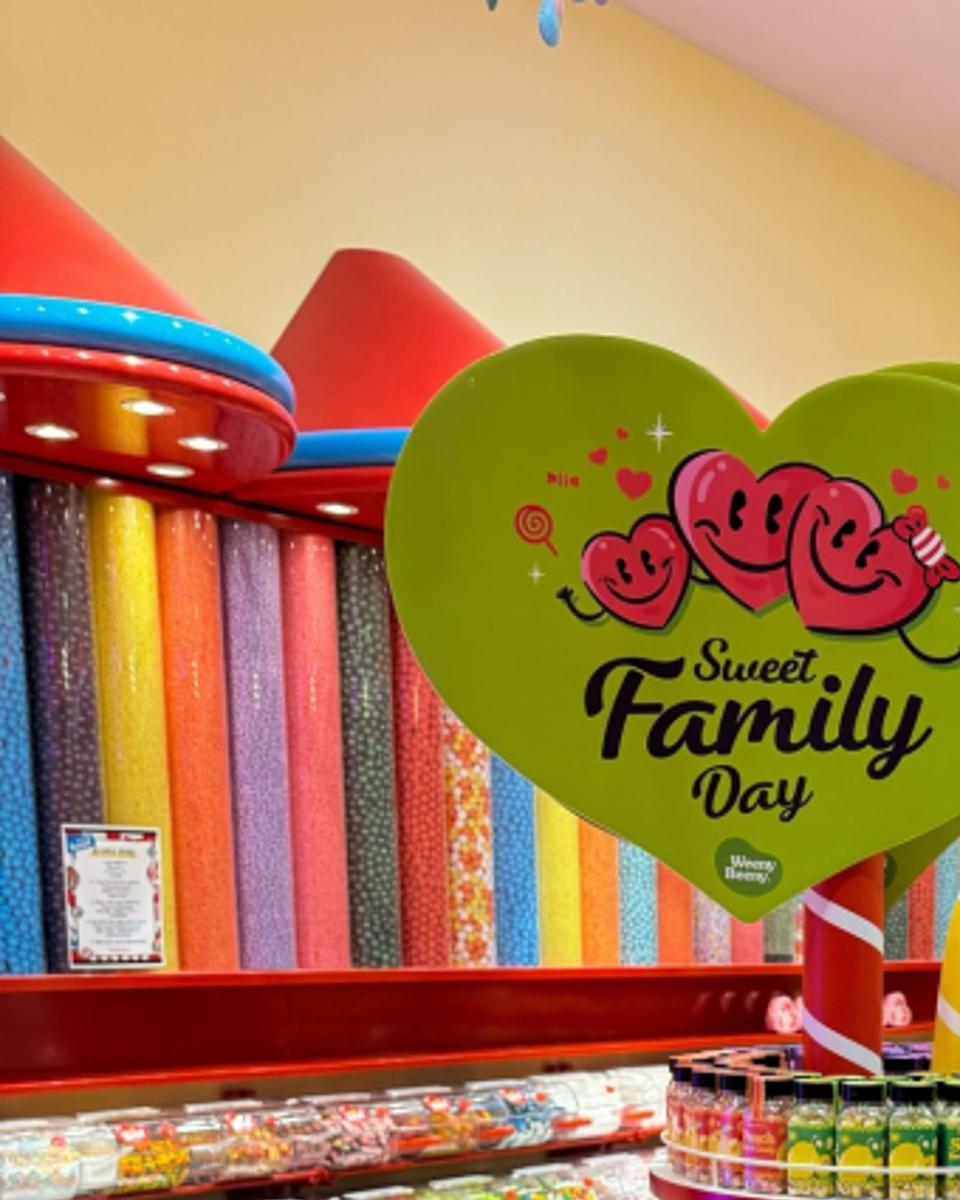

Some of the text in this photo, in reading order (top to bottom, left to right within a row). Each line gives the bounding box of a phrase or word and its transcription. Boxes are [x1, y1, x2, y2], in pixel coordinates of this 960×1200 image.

[694, 637, 819, 684] Sweet
[584, 656, 933, 780] Family
[691, 765, 814, 822] Day
[730, 855, 777, 873] Weeny
